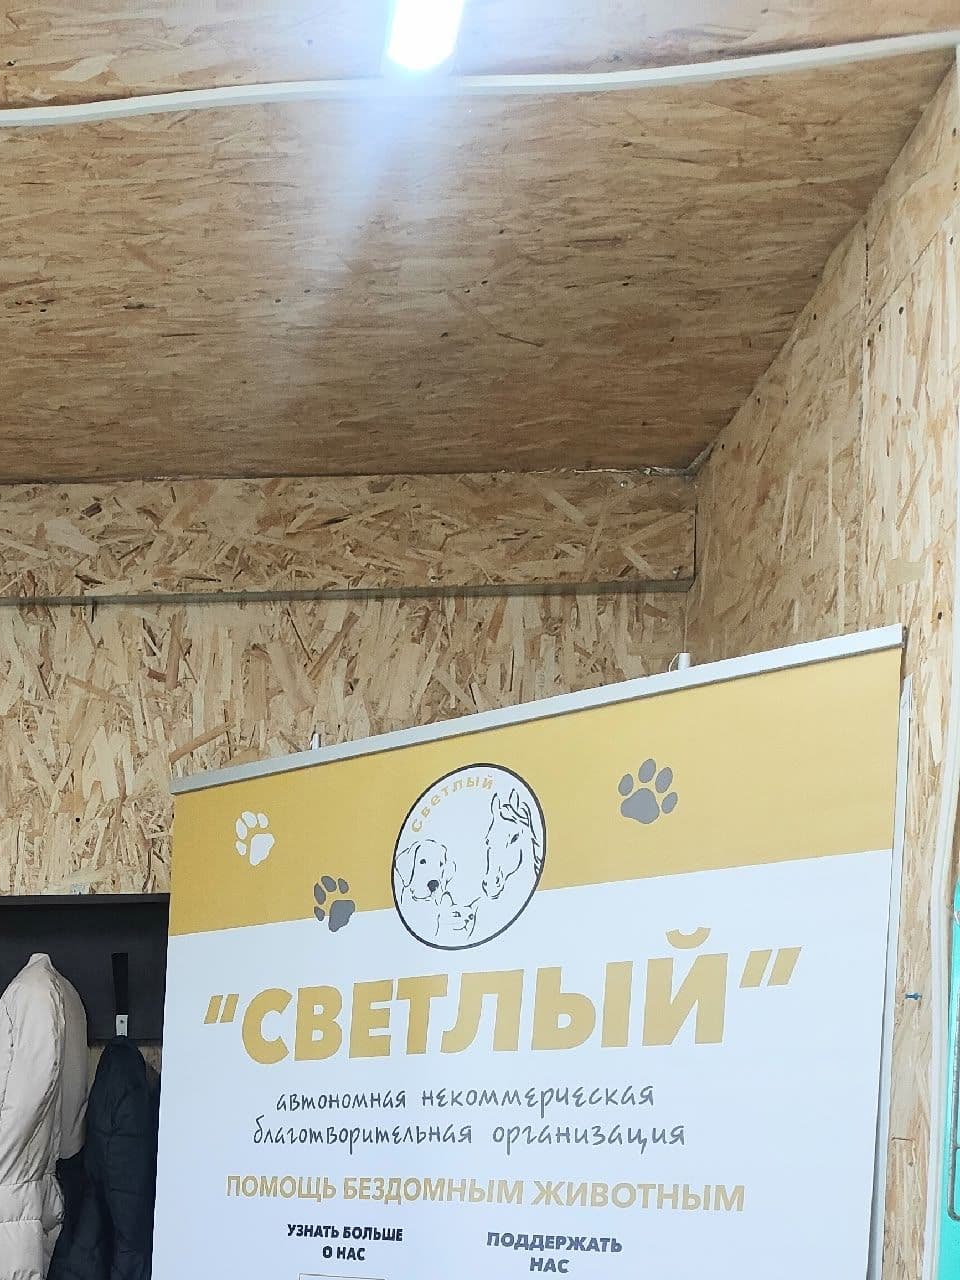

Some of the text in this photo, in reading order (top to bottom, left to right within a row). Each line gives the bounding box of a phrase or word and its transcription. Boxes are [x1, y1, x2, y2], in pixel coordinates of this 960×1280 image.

[276, 1085, 655, 1118] автономная некоммерческая
[253, 1115, 686, 1155] благотворительная организация
[226, 1174, 746, 1213] ПОМОЩЬ БЕЗДОМНЫМ ЖИВОТНЫМ
[287, 1223, 404, 1242] УЗНАТЬ БОЛЬШЕ
[487, 1232, 623, 1253] ПОДДЕРЖАТЬ
[322, 1246, 366, 1261] О НАС
[529, 1257, 570, 1274] НАС
